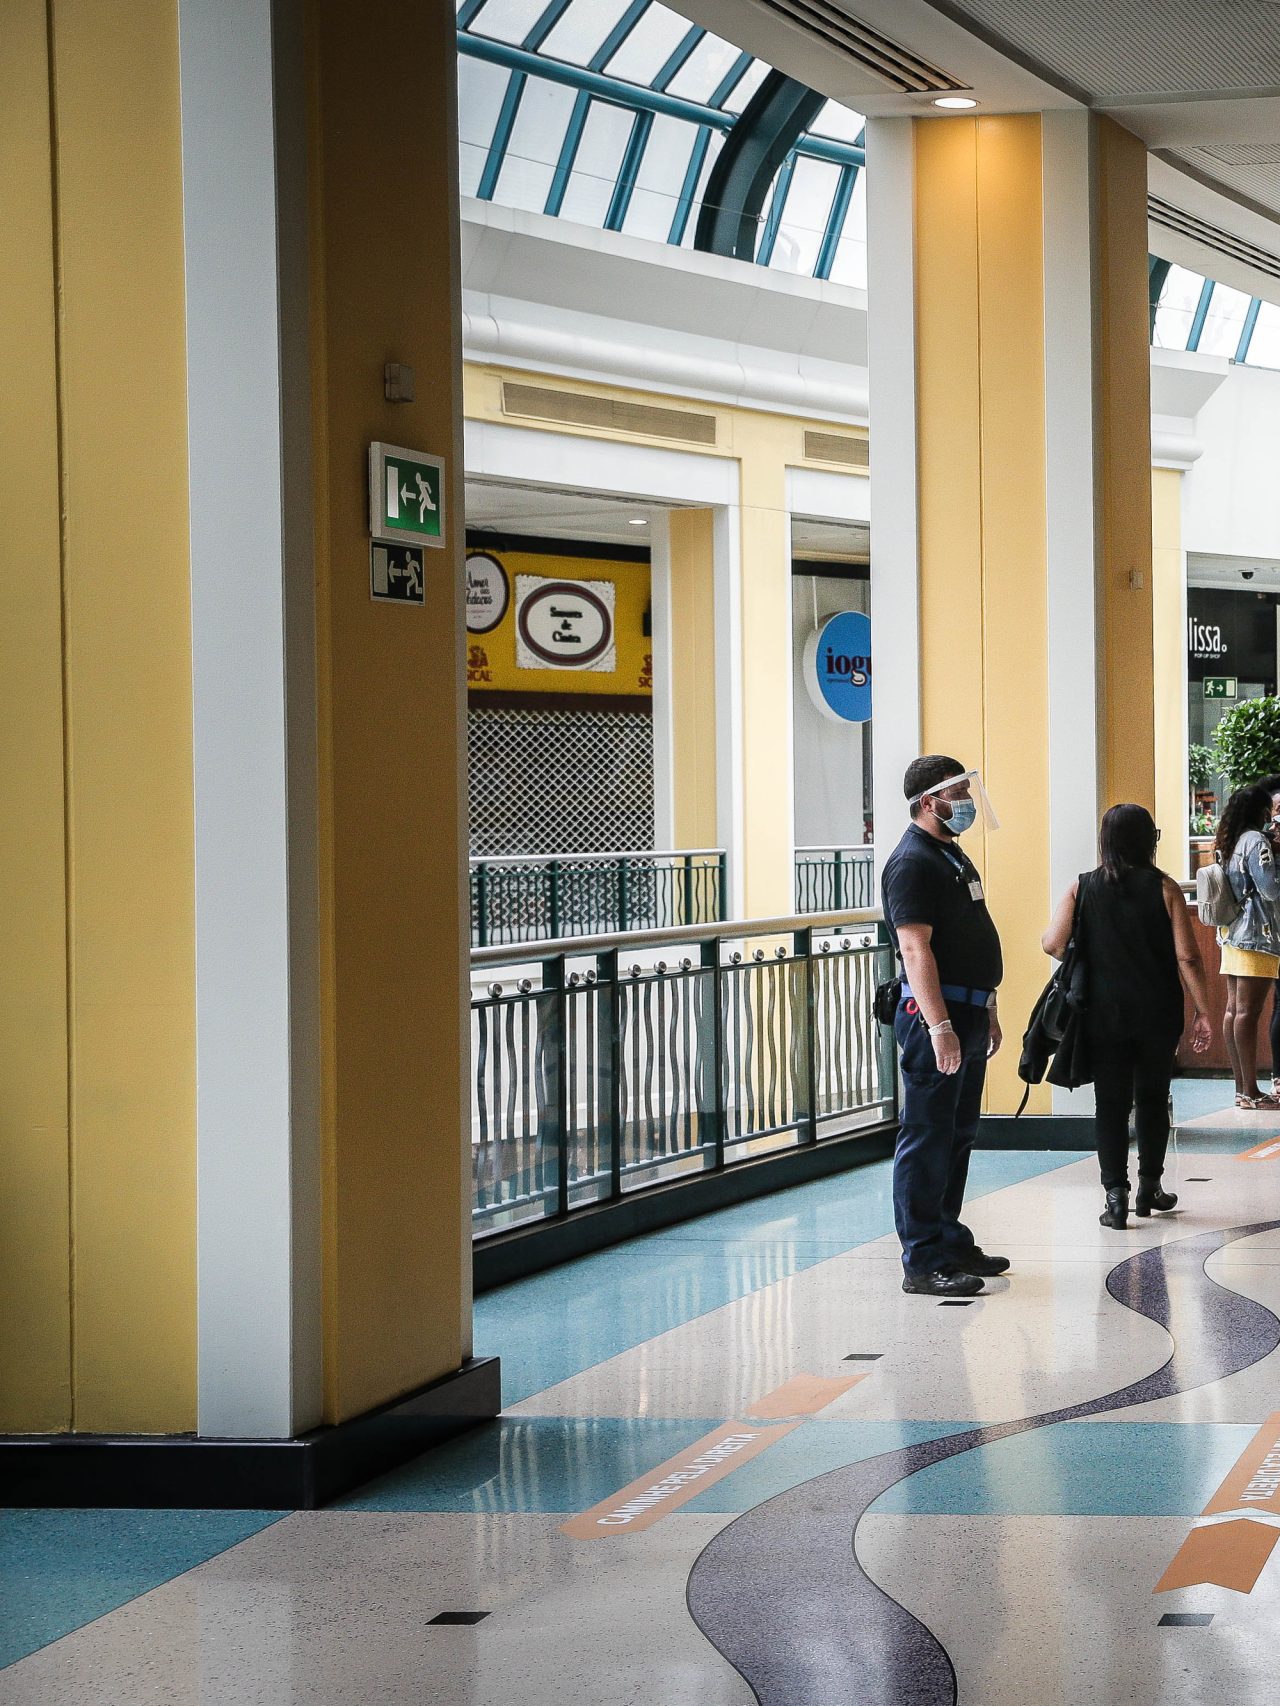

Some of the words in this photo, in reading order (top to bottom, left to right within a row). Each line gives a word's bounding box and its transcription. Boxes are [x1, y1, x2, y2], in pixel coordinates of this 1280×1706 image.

[597, 1485, 683, 1525] CAMINHE
[659, 1464, 716, 1484] PELA
[692, 1433, 762, 1464] DIREITA
